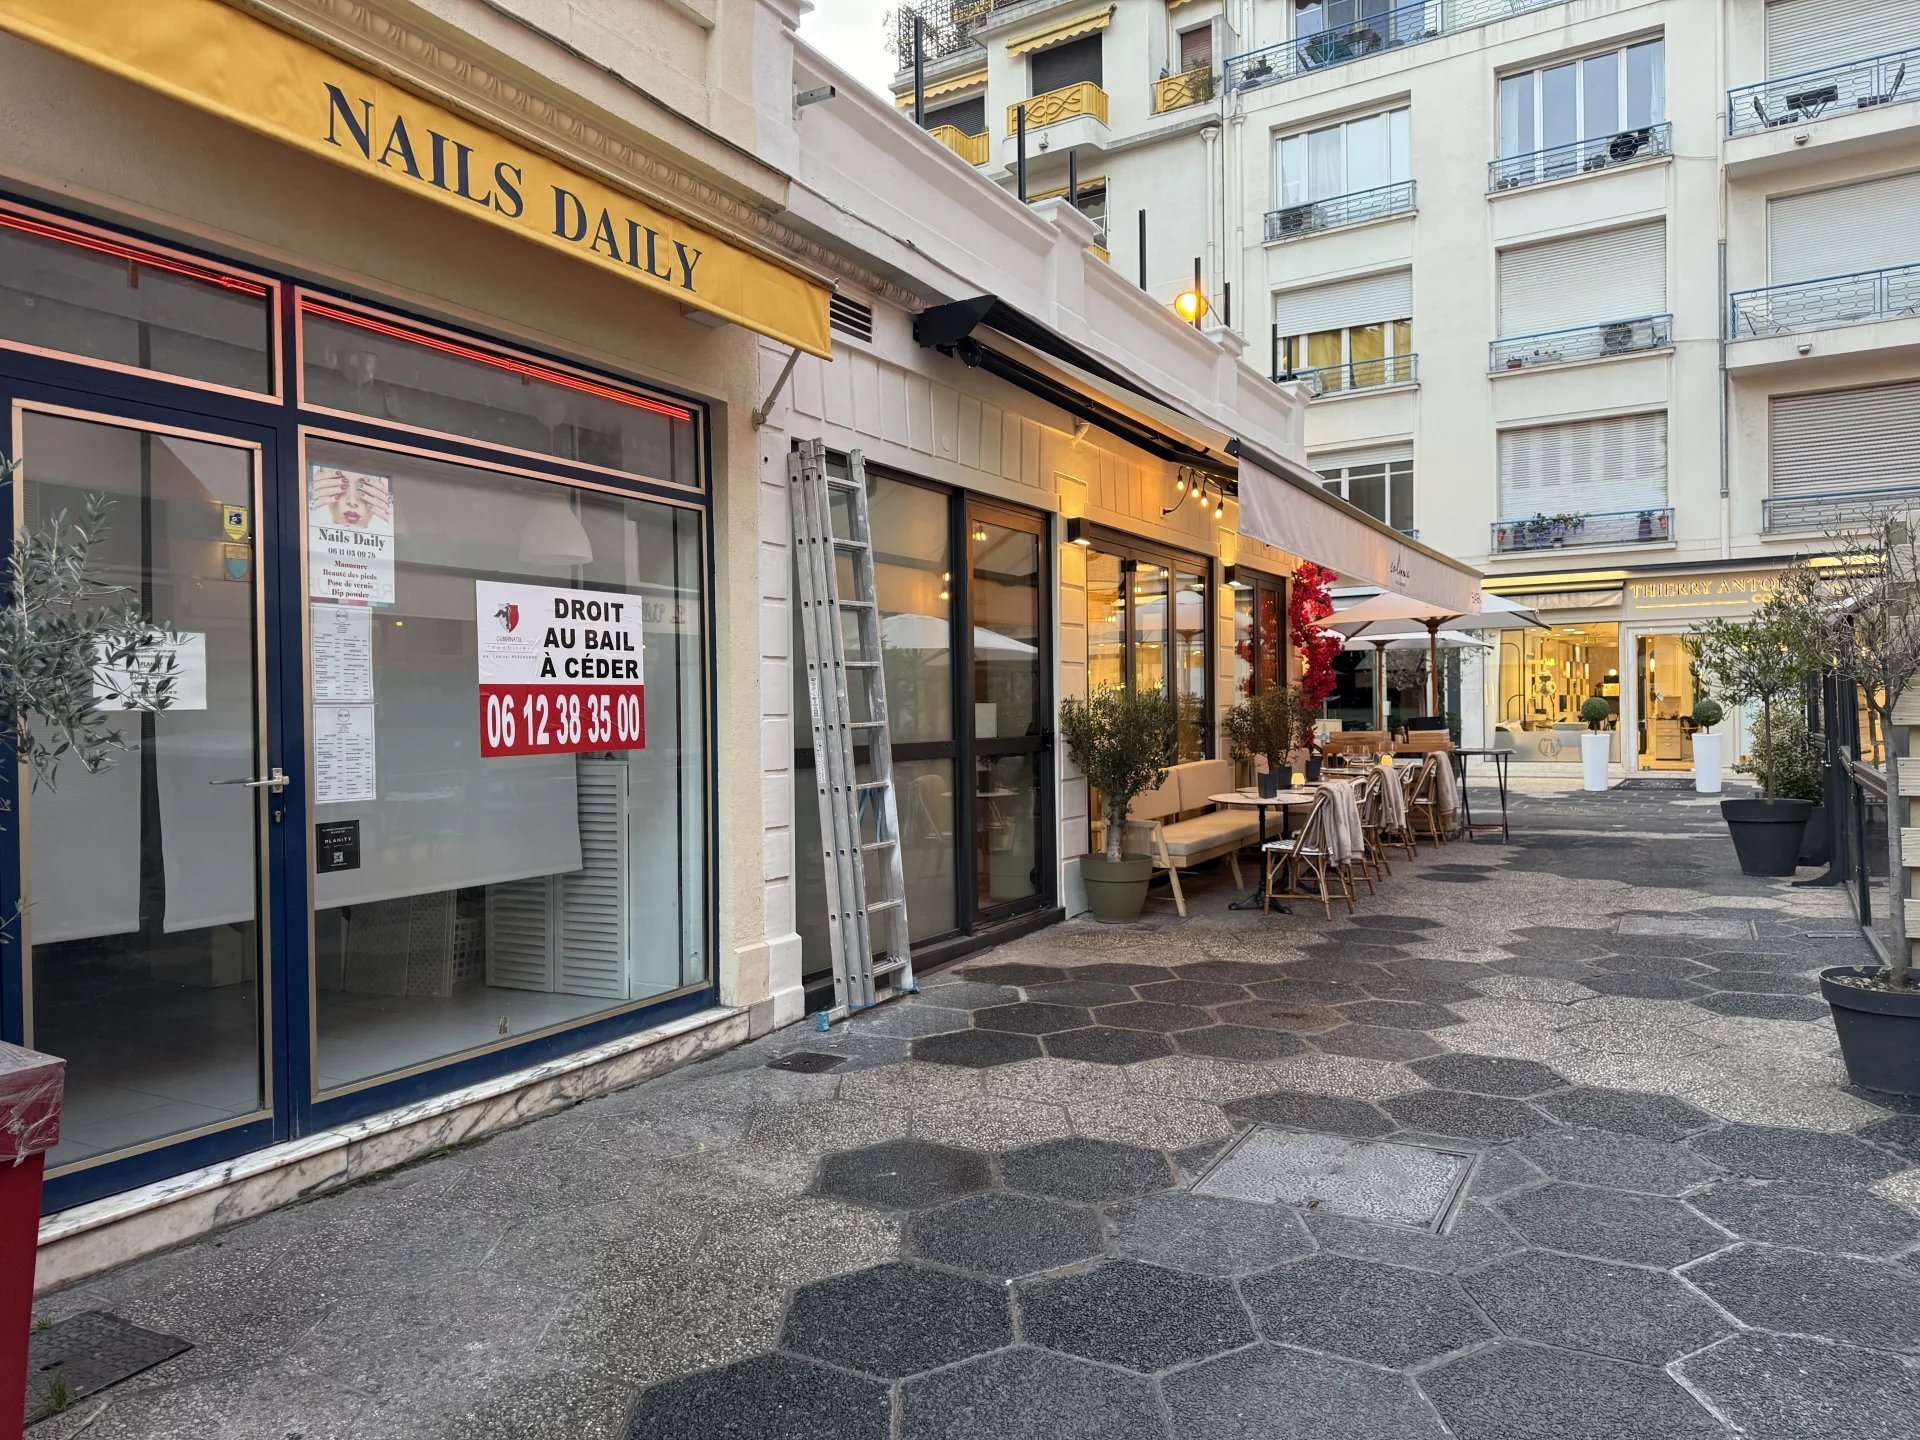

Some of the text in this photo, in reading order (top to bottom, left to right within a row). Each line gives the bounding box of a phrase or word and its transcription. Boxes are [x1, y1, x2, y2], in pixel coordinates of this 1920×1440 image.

[324, 83, 702, 292] NAILS DAILY
[319, 529, 386, 551] Nails Daily
[323, 569, 346, 577] Beauté
[327, 579, 342, 587] Pose
[344, 580, 352, 588] de
[332, 588, 370, 598] Dip powder
[1630, 581, 1713, 599] THIERRY
[554, 597, 624, 623] DROIT
[543, 627, 635, 651] AU BAIL
[540, 652, 639, 679] À CÉDER
[486, 694, 640, 748] 06 12 38 35 00
[324, 836, 352, 844] PLANITY
